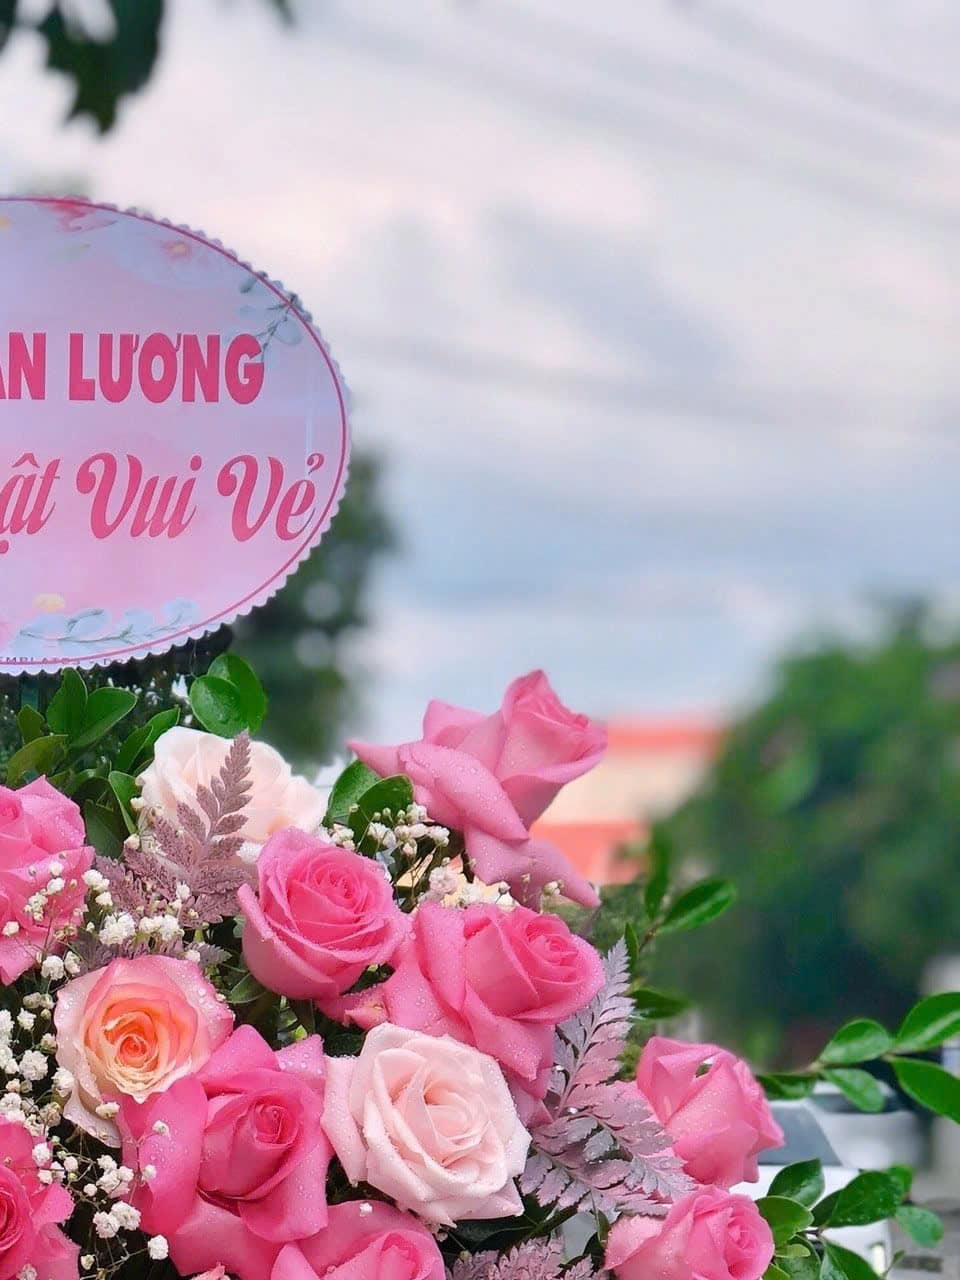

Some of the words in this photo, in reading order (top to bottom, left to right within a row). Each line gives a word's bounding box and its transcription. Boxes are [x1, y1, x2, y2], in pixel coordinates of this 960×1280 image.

[68, 332, 264, 405] LƯƠNG
[75, 451, 203, 540] Vui
[216, 451, 324, 542] Vẻ
